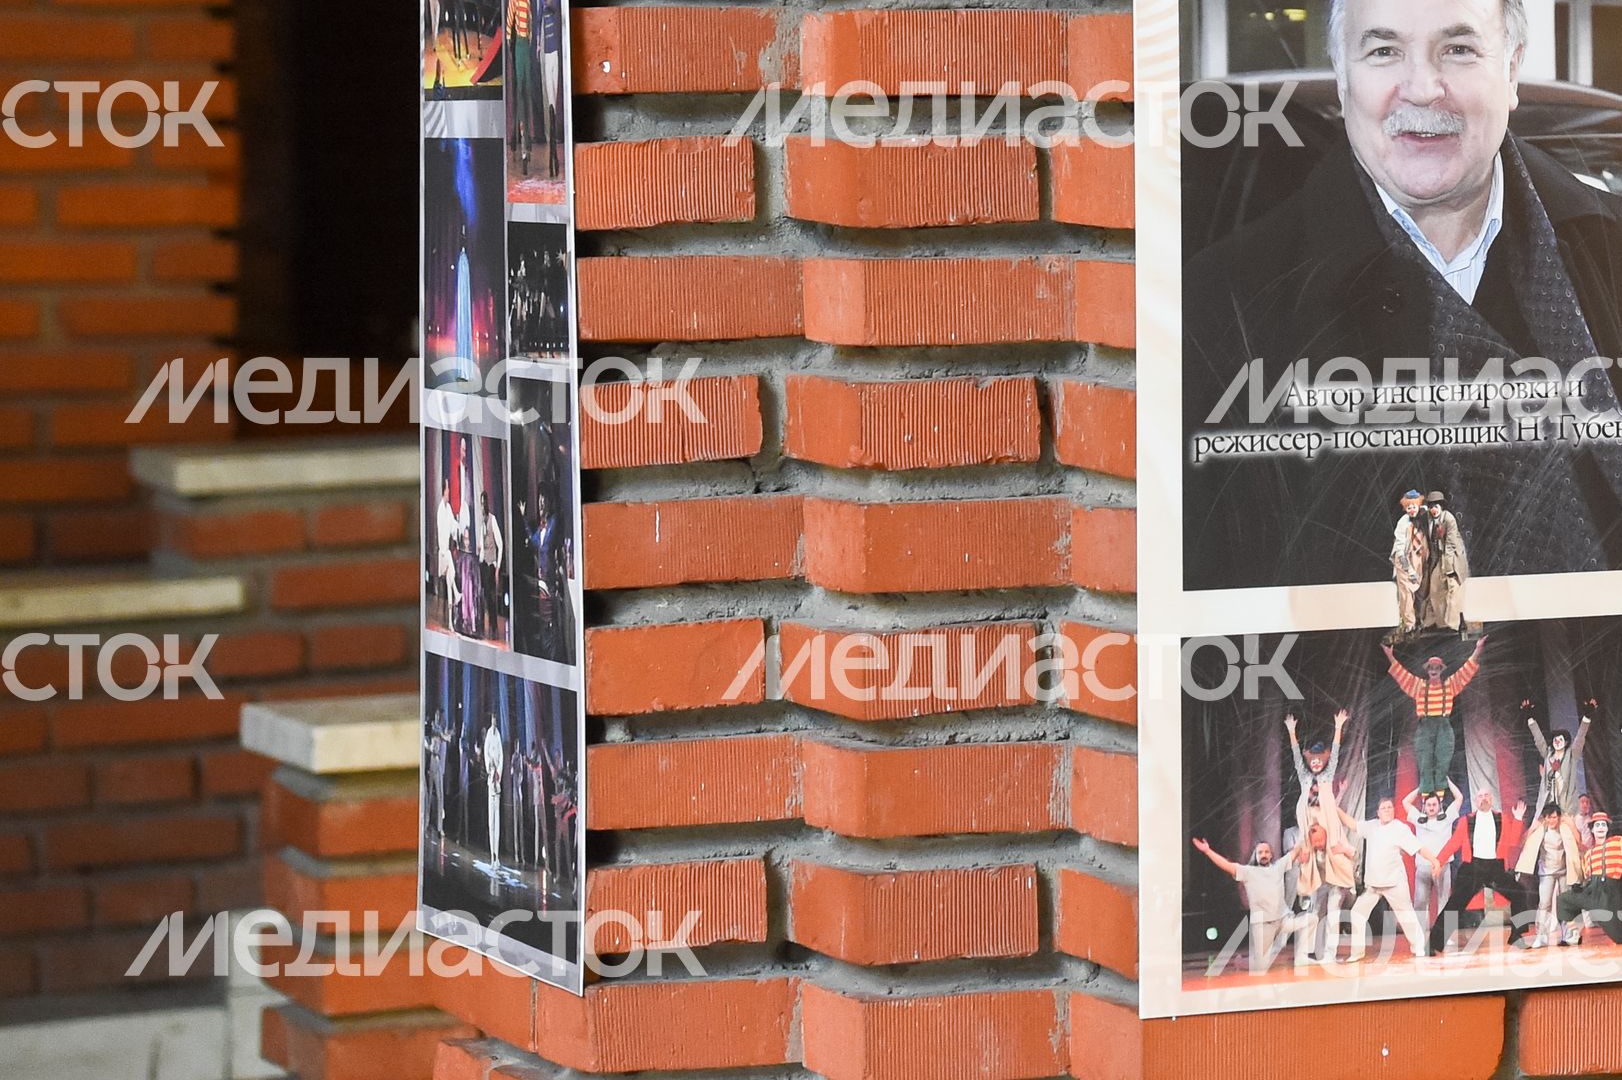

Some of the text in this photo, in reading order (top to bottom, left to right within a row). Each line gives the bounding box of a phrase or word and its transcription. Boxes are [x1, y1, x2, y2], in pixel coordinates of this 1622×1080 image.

[1283, 378, 1584, 413] Автор инсценировки и
[1193, 424, 1510, 464] режиссер-постановщик
[1515, 415, 1549, 442] Н.
